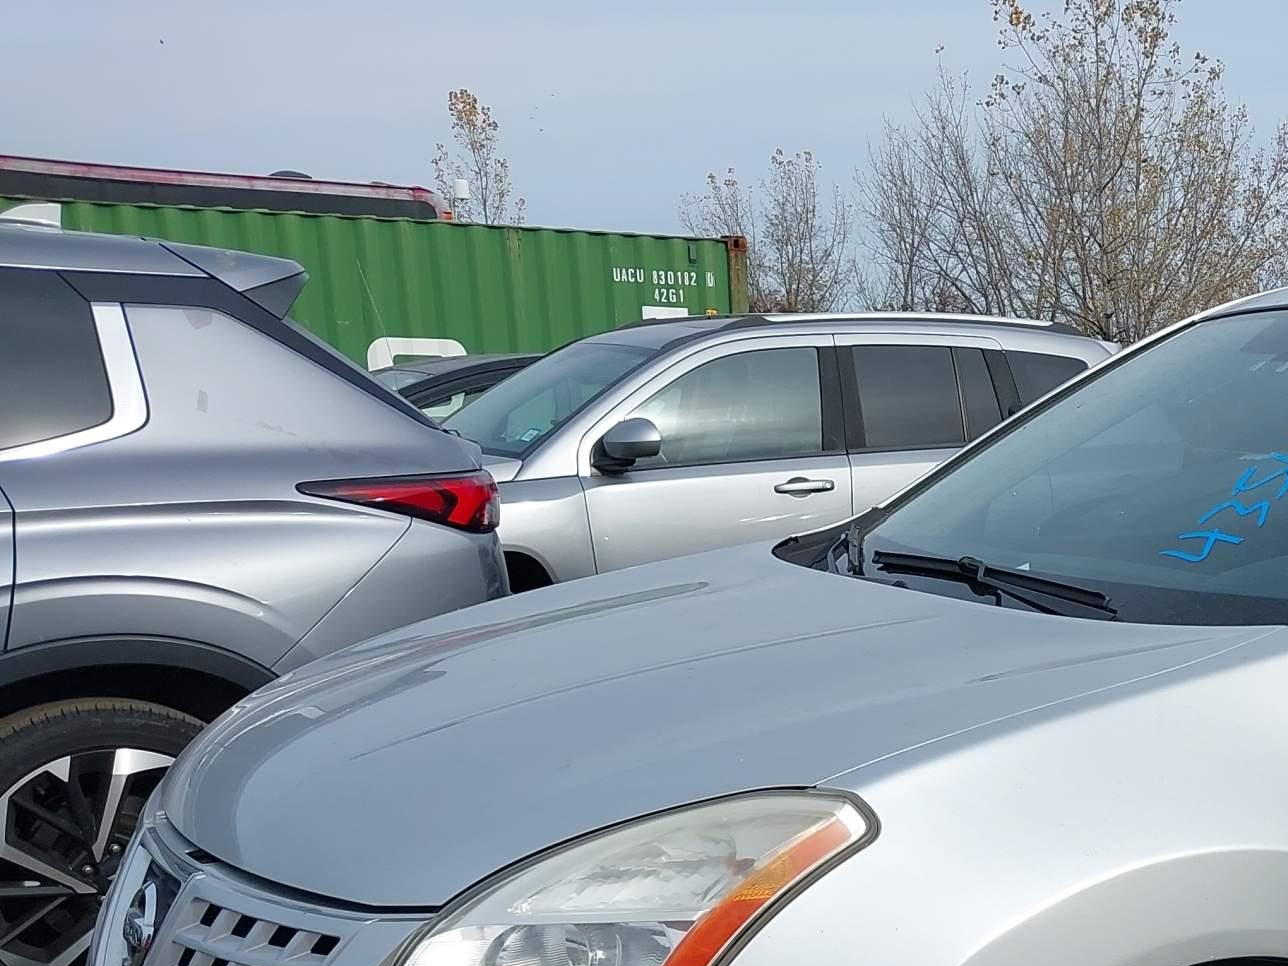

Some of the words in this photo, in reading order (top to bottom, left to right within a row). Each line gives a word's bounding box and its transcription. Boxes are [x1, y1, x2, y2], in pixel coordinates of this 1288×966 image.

[612, 267, 644, 283] UACU
[652, 270, 697, 286] 830182
[654, 288, 684, 303] 42G1
